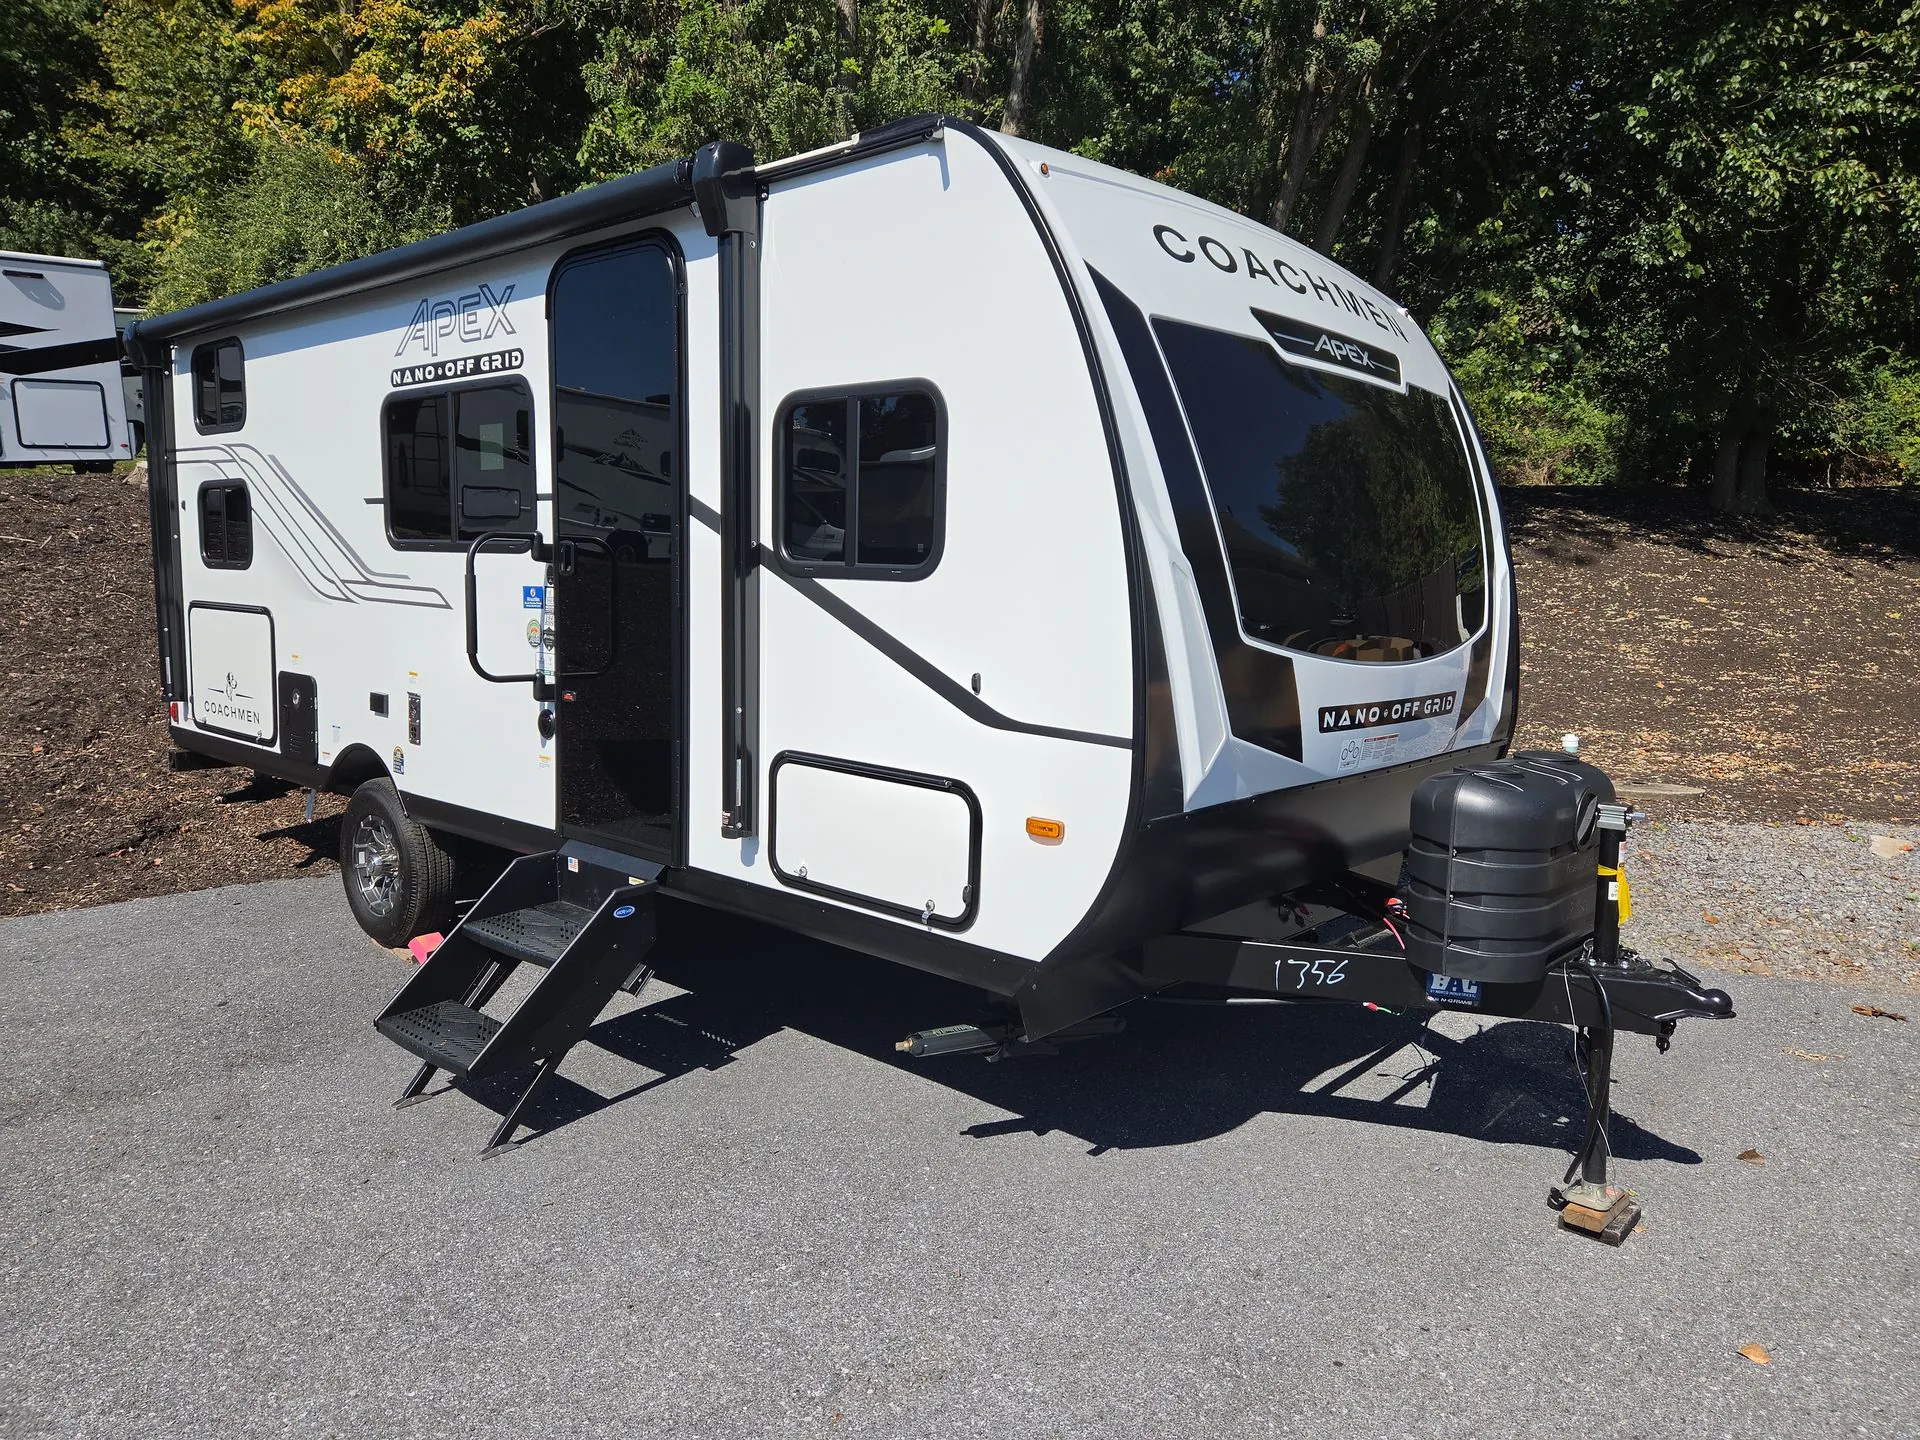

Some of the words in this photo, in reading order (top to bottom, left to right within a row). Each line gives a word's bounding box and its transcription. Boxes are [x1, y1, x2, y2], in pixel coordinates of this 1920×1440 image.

[1152, 223, 1409, 343] COACHMEN
[394, 283, 517, 357] APEX
[392, 365, 435, 385] NANO
[445, 358, 475, 376] OFF
[480, 351, 522, 370] GRID
[1314, 334, 1375, 369] APEX
[204, 700, 260, 724] COACHMEN
[1323, 706, 1380, 728] NANO
[1391, 701, 1420, 720] OFF
[1424, 695, 1454, 714] GRID
[1274, 959, 1349, 991] 1356
